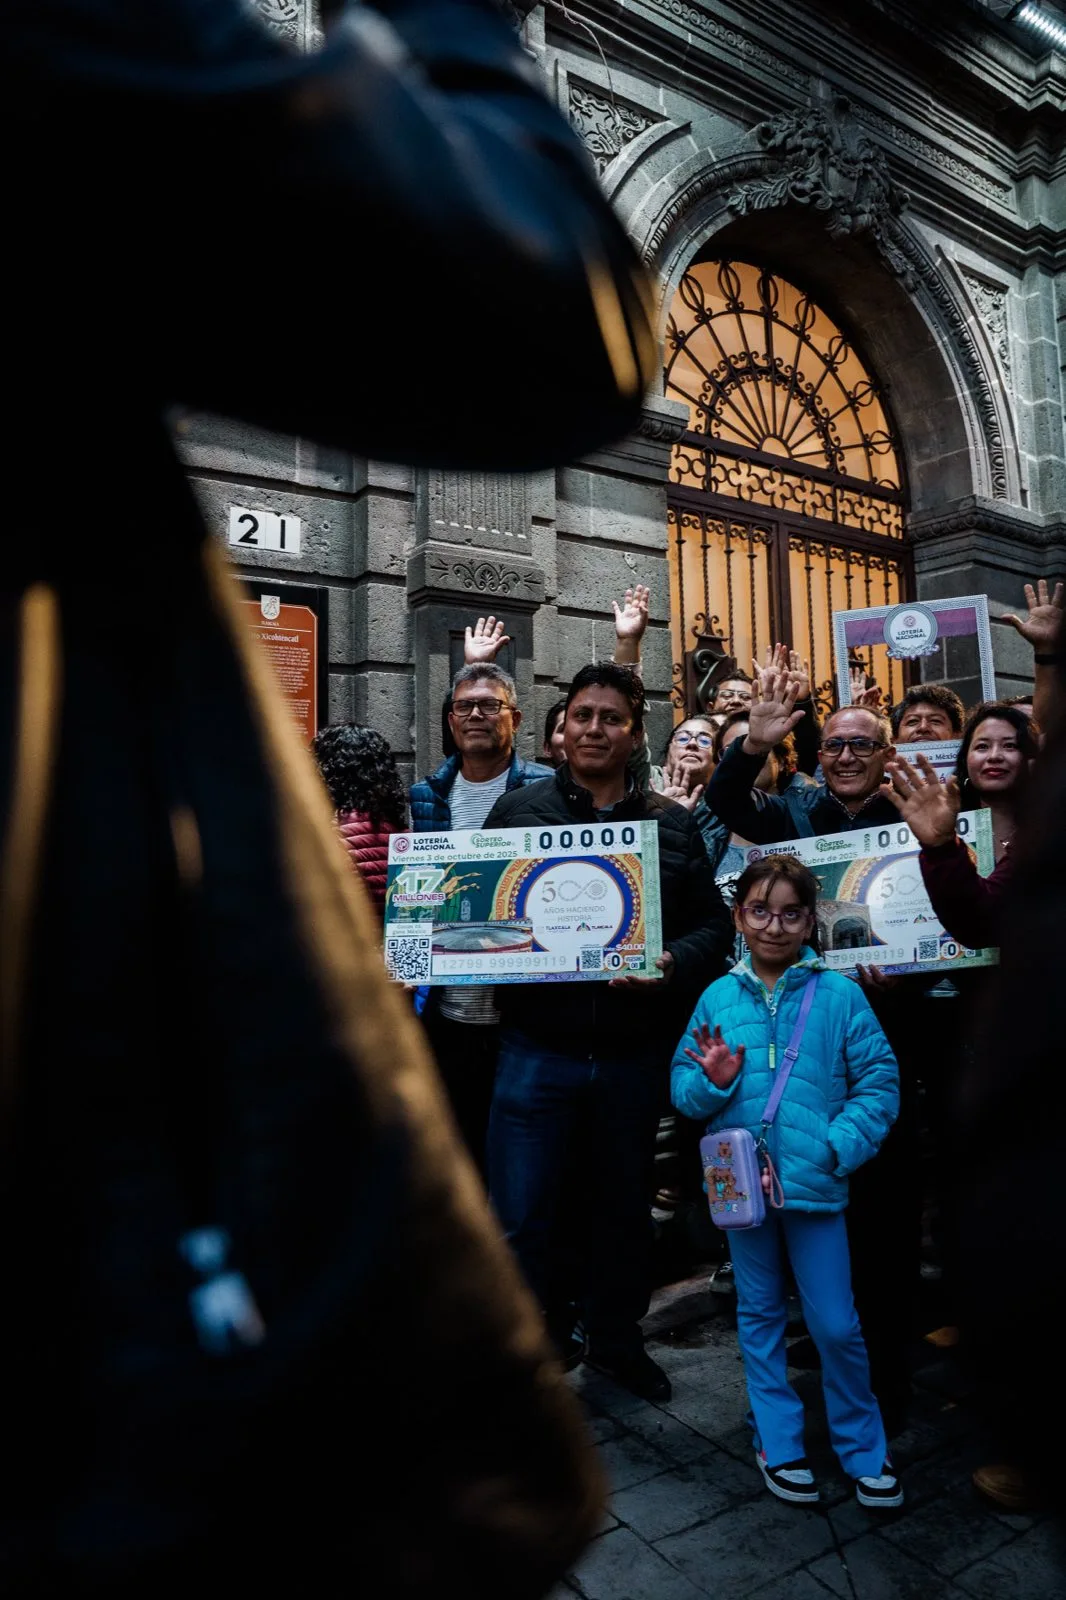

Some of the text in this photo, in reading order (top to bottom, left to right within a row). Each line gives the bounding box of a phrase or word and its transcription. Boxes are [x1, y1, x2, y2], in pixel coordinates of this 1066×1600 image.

[238, 513, 286, 549] 21
[898, 628, 923, 636] LOTERÍA
[896, 633, 927, 641] NACIONAL
[413, 836, 449, 845] LOTERÍA
[476, 841, 512, 849] SUPERIOR
[413, 844, 456, 852] NACIONAL
[764, 846, 796, 855] LOTERÍA
[392, 850, 518, 863] Viernes 3 de octubre de 2025
[396, 869, 445, 895] 17
[394, 893, 445, 902] MILLONES
[567, 905, 606, 913] HACIENDO
[948, 944, 956, 955] 0
[441, 959, 483, 969] 12799
[612, 955, 620, 967] 0
